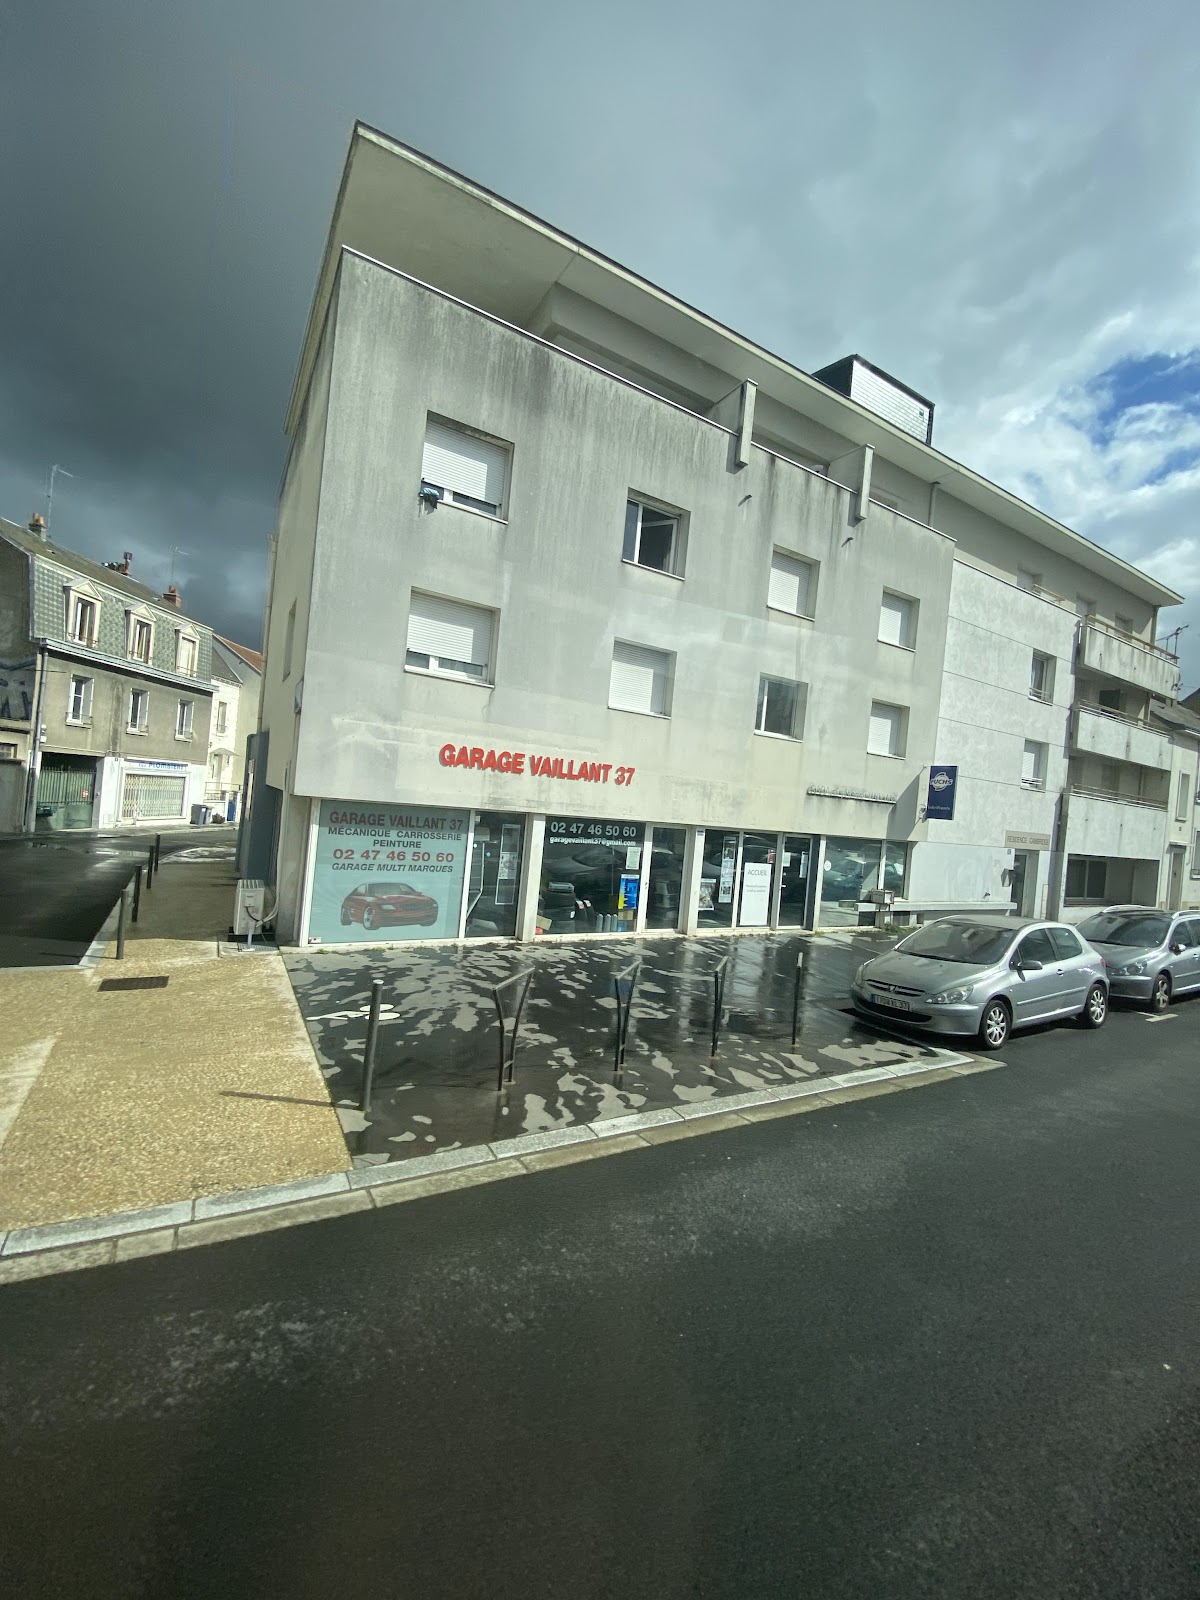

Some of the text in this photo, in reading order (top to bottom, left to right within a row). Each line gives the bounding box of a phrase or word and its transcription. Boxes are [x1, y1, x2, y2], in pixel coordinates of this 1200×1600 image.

[439, 743, 636, 786] GARAGE VAILLANT 37
[329, 811, 463, 831] GARAGE VAILLANT 37
[550, 821, 637, 838] 02 47 46 50 60
[396, 831, 462, 841] CARROSSERIE
[373, 839, 422, 849] PEINTURE
[333, 849, 454, 863] 02 47 46 50 60
[331, 862, 454, 873] GARAGE MULTI MARQUES
[747, 869, 768, 877] ACCUEIL
